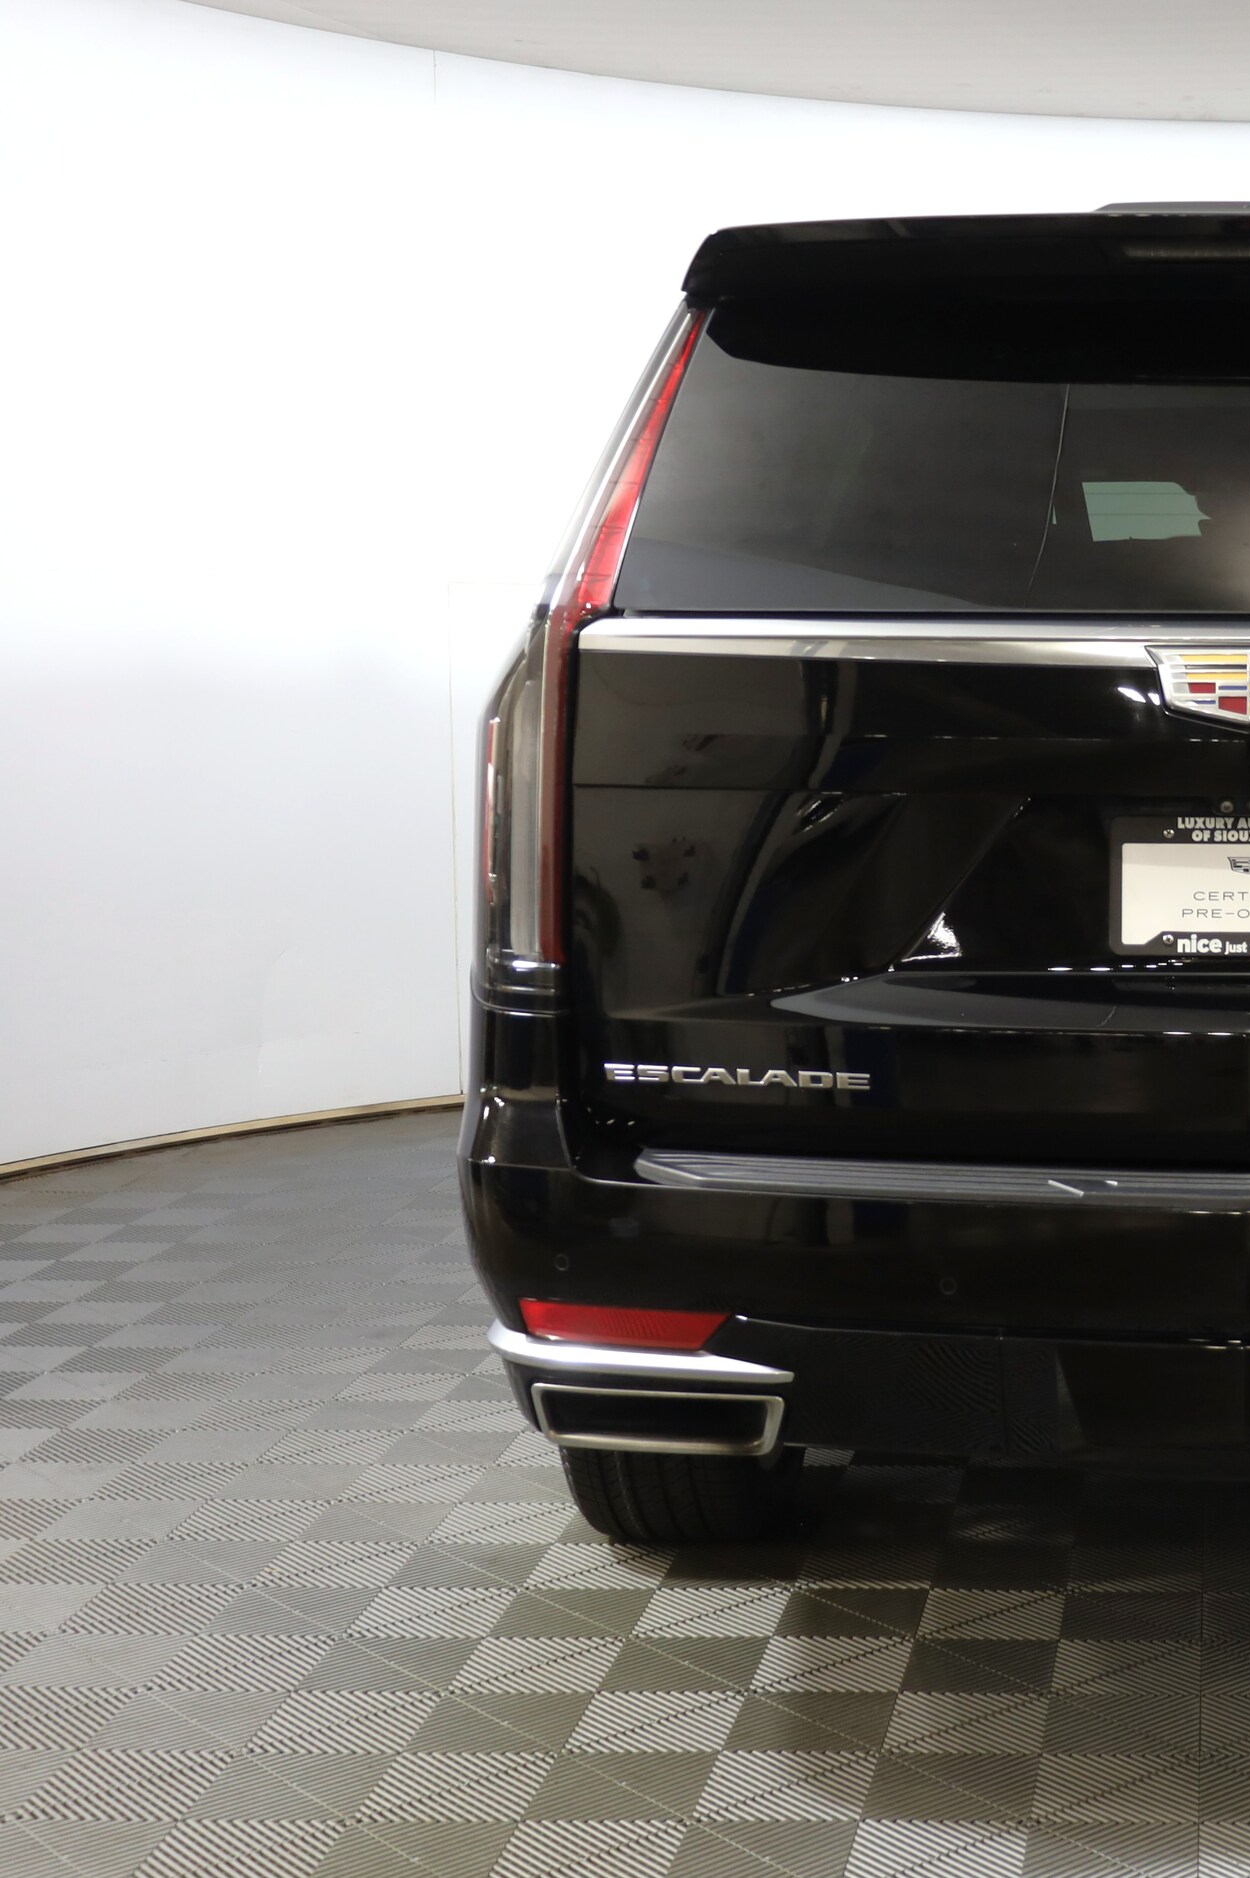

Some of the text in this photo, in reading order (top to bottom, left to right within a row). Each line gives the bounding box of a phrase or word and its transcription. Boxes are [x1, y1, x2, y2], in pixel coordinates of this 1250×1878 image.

[1177, 817, 1233, 829] LUXURY
[1191, 830, 1210, 842] OF
[1177, 934, 1222, 953] nice
[1224, 941, 1248, 955] just
[604, 1063, 870, 1090] ESCALADE
